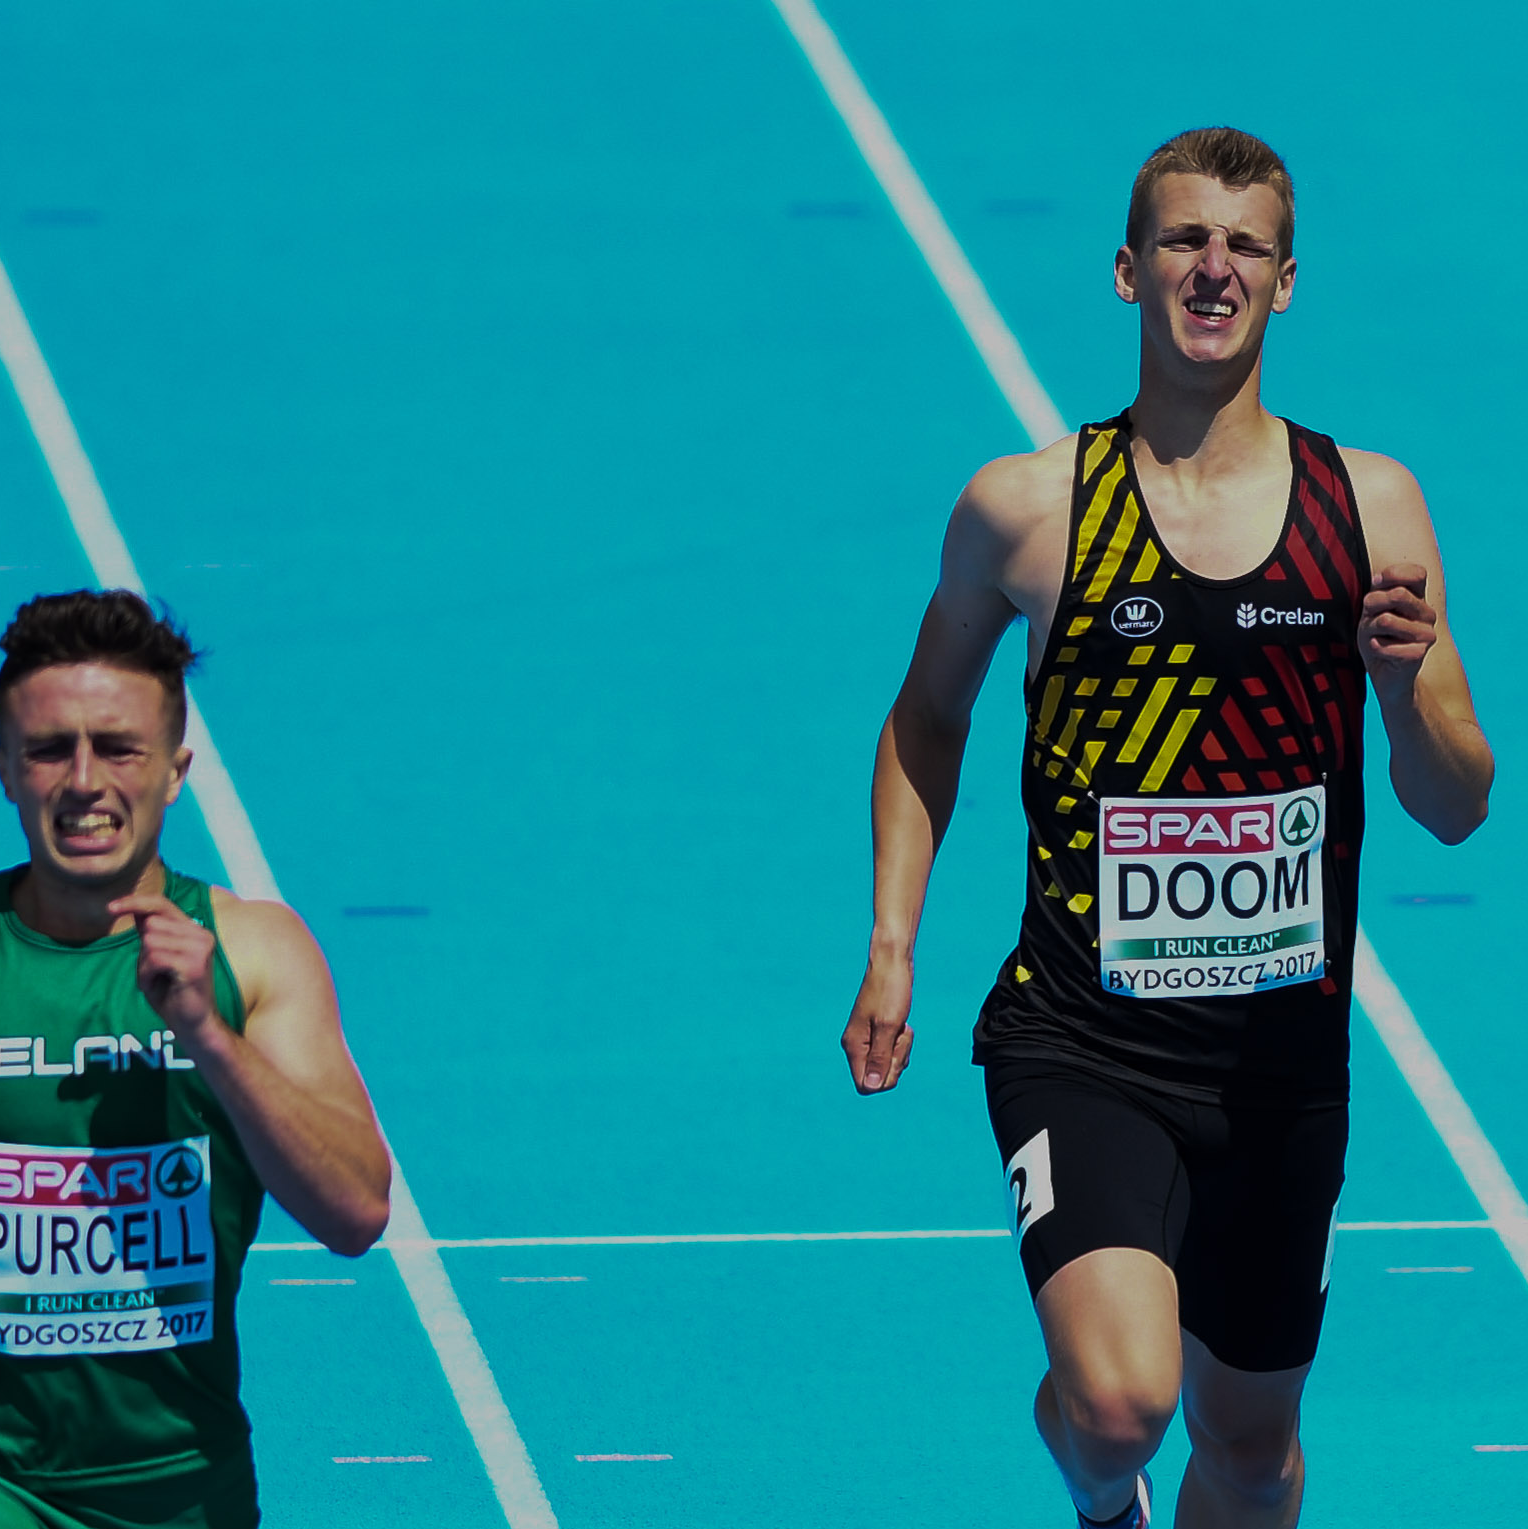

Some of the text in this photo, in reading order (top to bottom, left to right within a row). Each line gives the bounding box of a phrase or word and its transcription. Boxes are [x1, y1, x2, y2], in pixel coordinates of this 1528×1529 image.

[1260, 606, 1325, 626] Crelan
[1107, 810, 1271, 849] SPAR
[1117, 850, 1311, 922] DOOM
[1153, 934, 1274, 957] I RUN CLEAN
[1108, 951, 1316, 990] BYDGOSZCZ 2017
[24, 1290, 155, 1313] I RUN CLEAN
[156, 1311, 207, 1338] 2017
